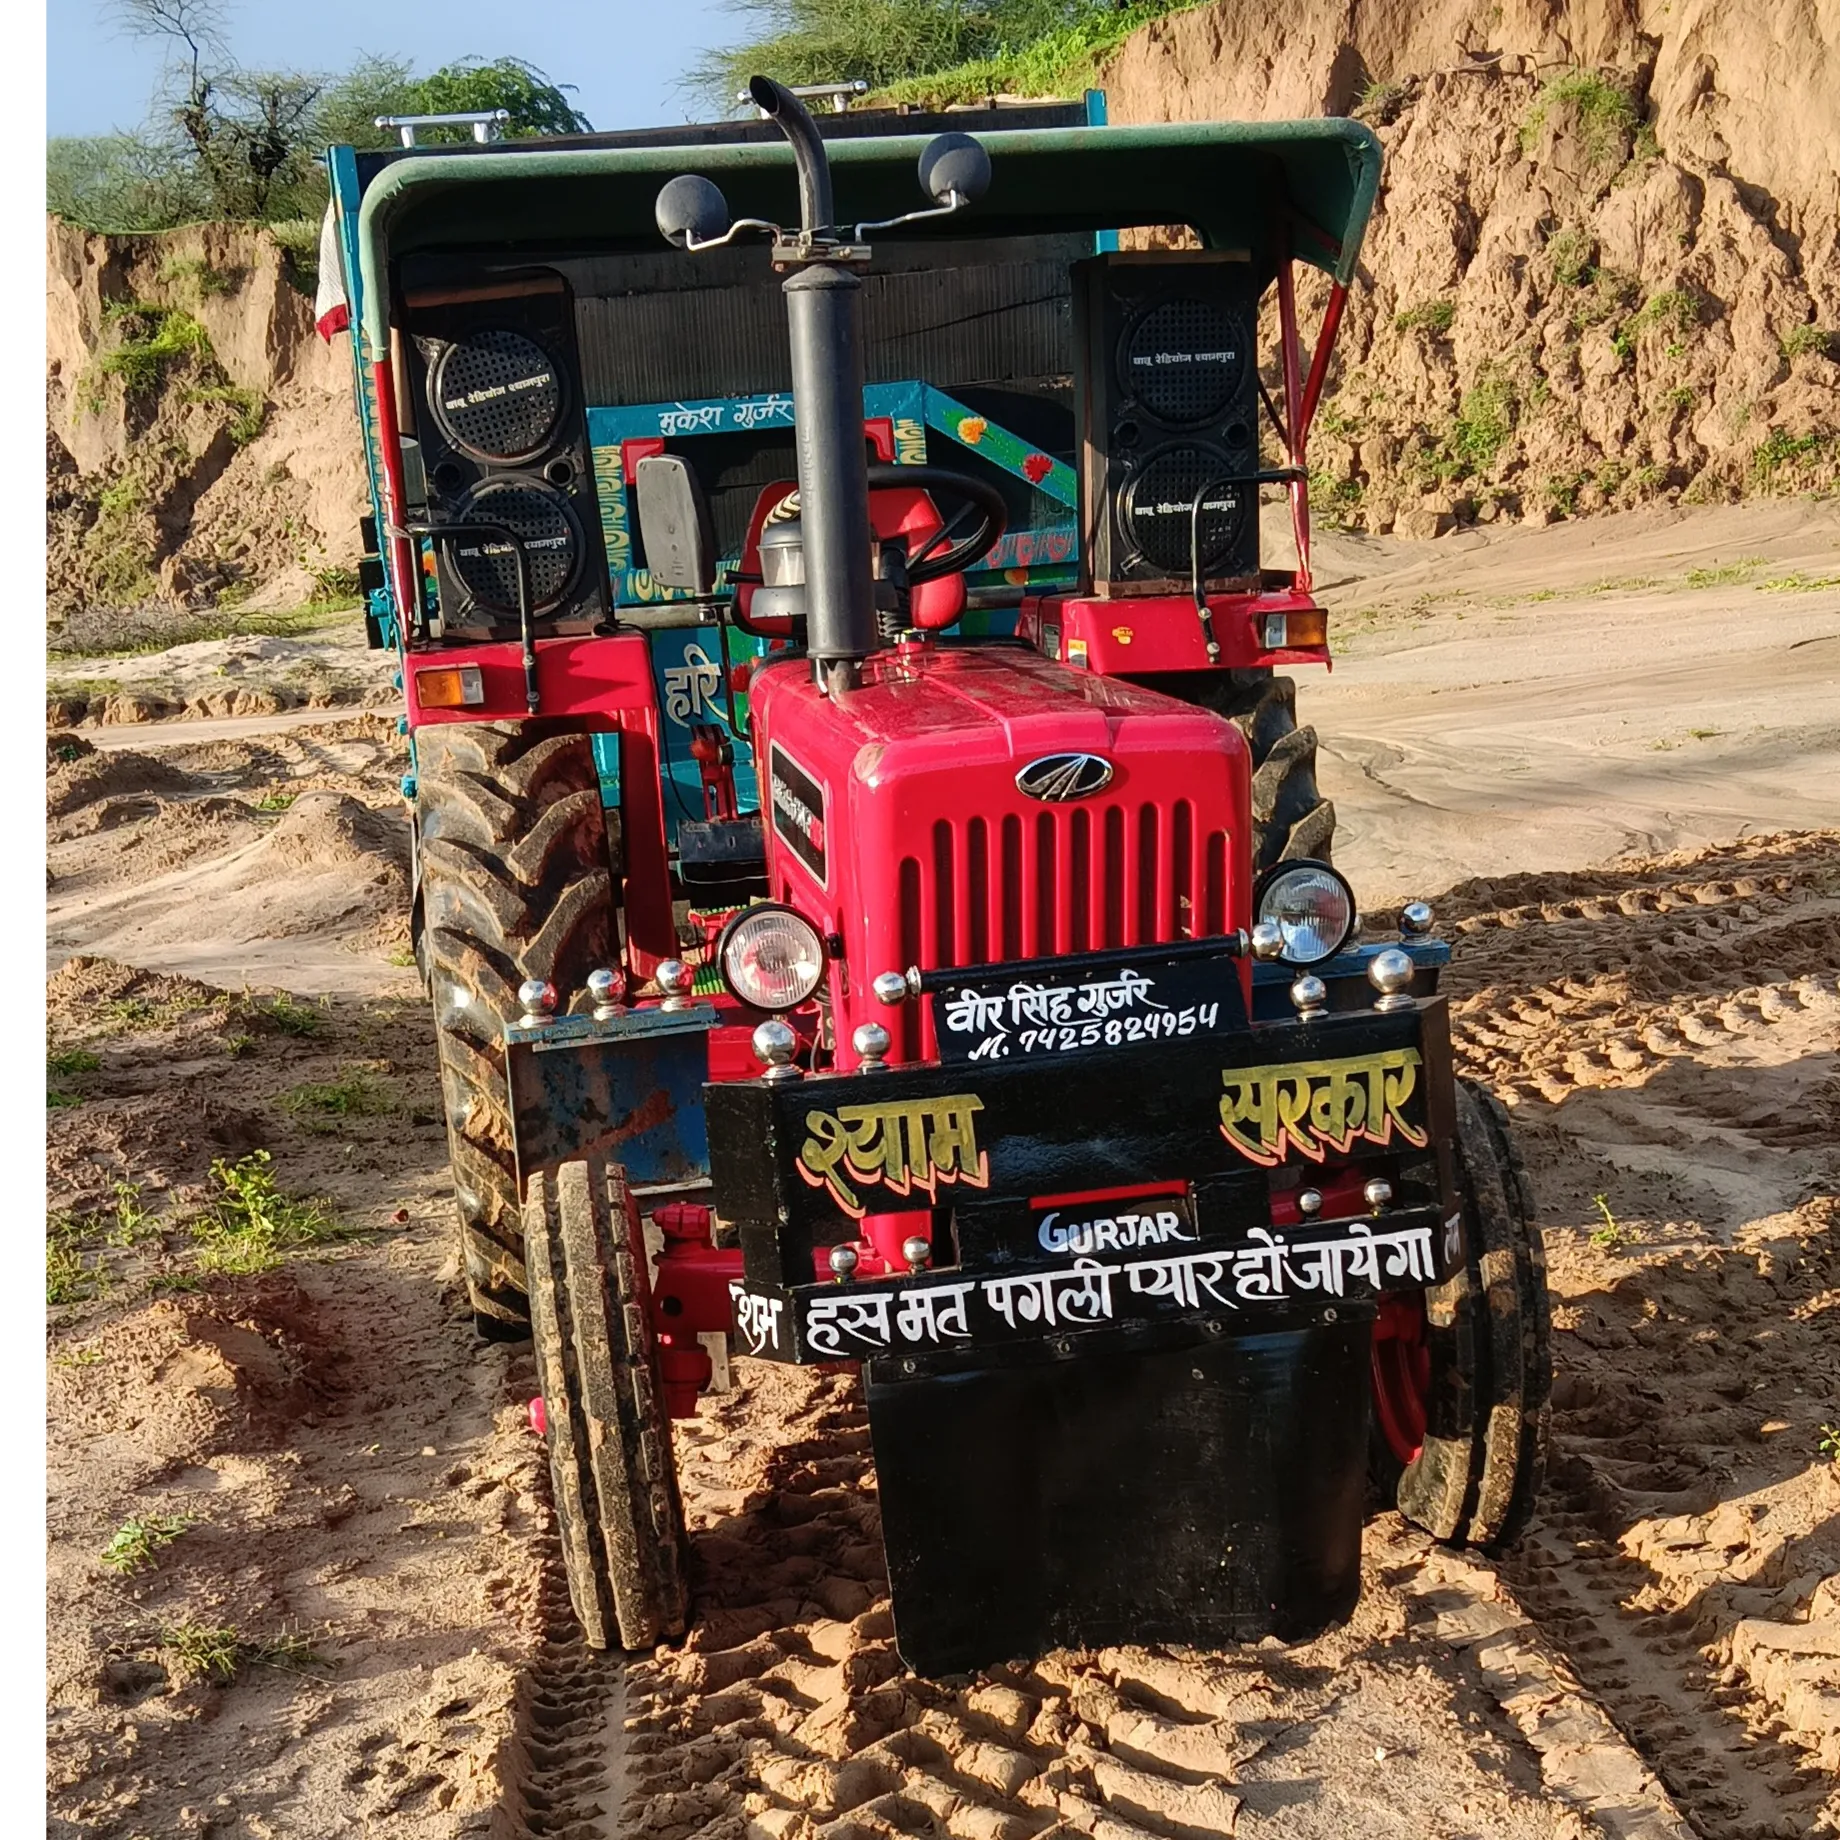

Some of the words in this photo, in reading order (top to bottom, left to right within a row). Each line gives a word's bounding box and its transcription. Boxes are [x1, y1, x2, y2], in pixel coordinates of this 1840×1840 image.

[658, 402, 725, 436] मुकेश
[733, 393, 794, 428] गुर्जर
[664, 643, 729, 729] हरि
[946, 989, 1012, 1033] वीर
[1006, 983, 1102, 1026] सिंह
[1077, 968, 1169, 1018] गुर्जर
[1018, 1002, 1219, 1052] 7425824954
[1219, 1047, 1428, 1166] सरकार
[797, 1093, 989, 1217] श्याम
[1038, 1211, 1200, 1254] GURJAR
[806, 1293, 893, 1356] हस
[897, 1280, 978, 1343] मत
[982, 1257, 1121, 1329] पगली
[1124, 1251, 1239, 1309] प्यार
[1283, 1223, 1436, 1297] जायेगा
